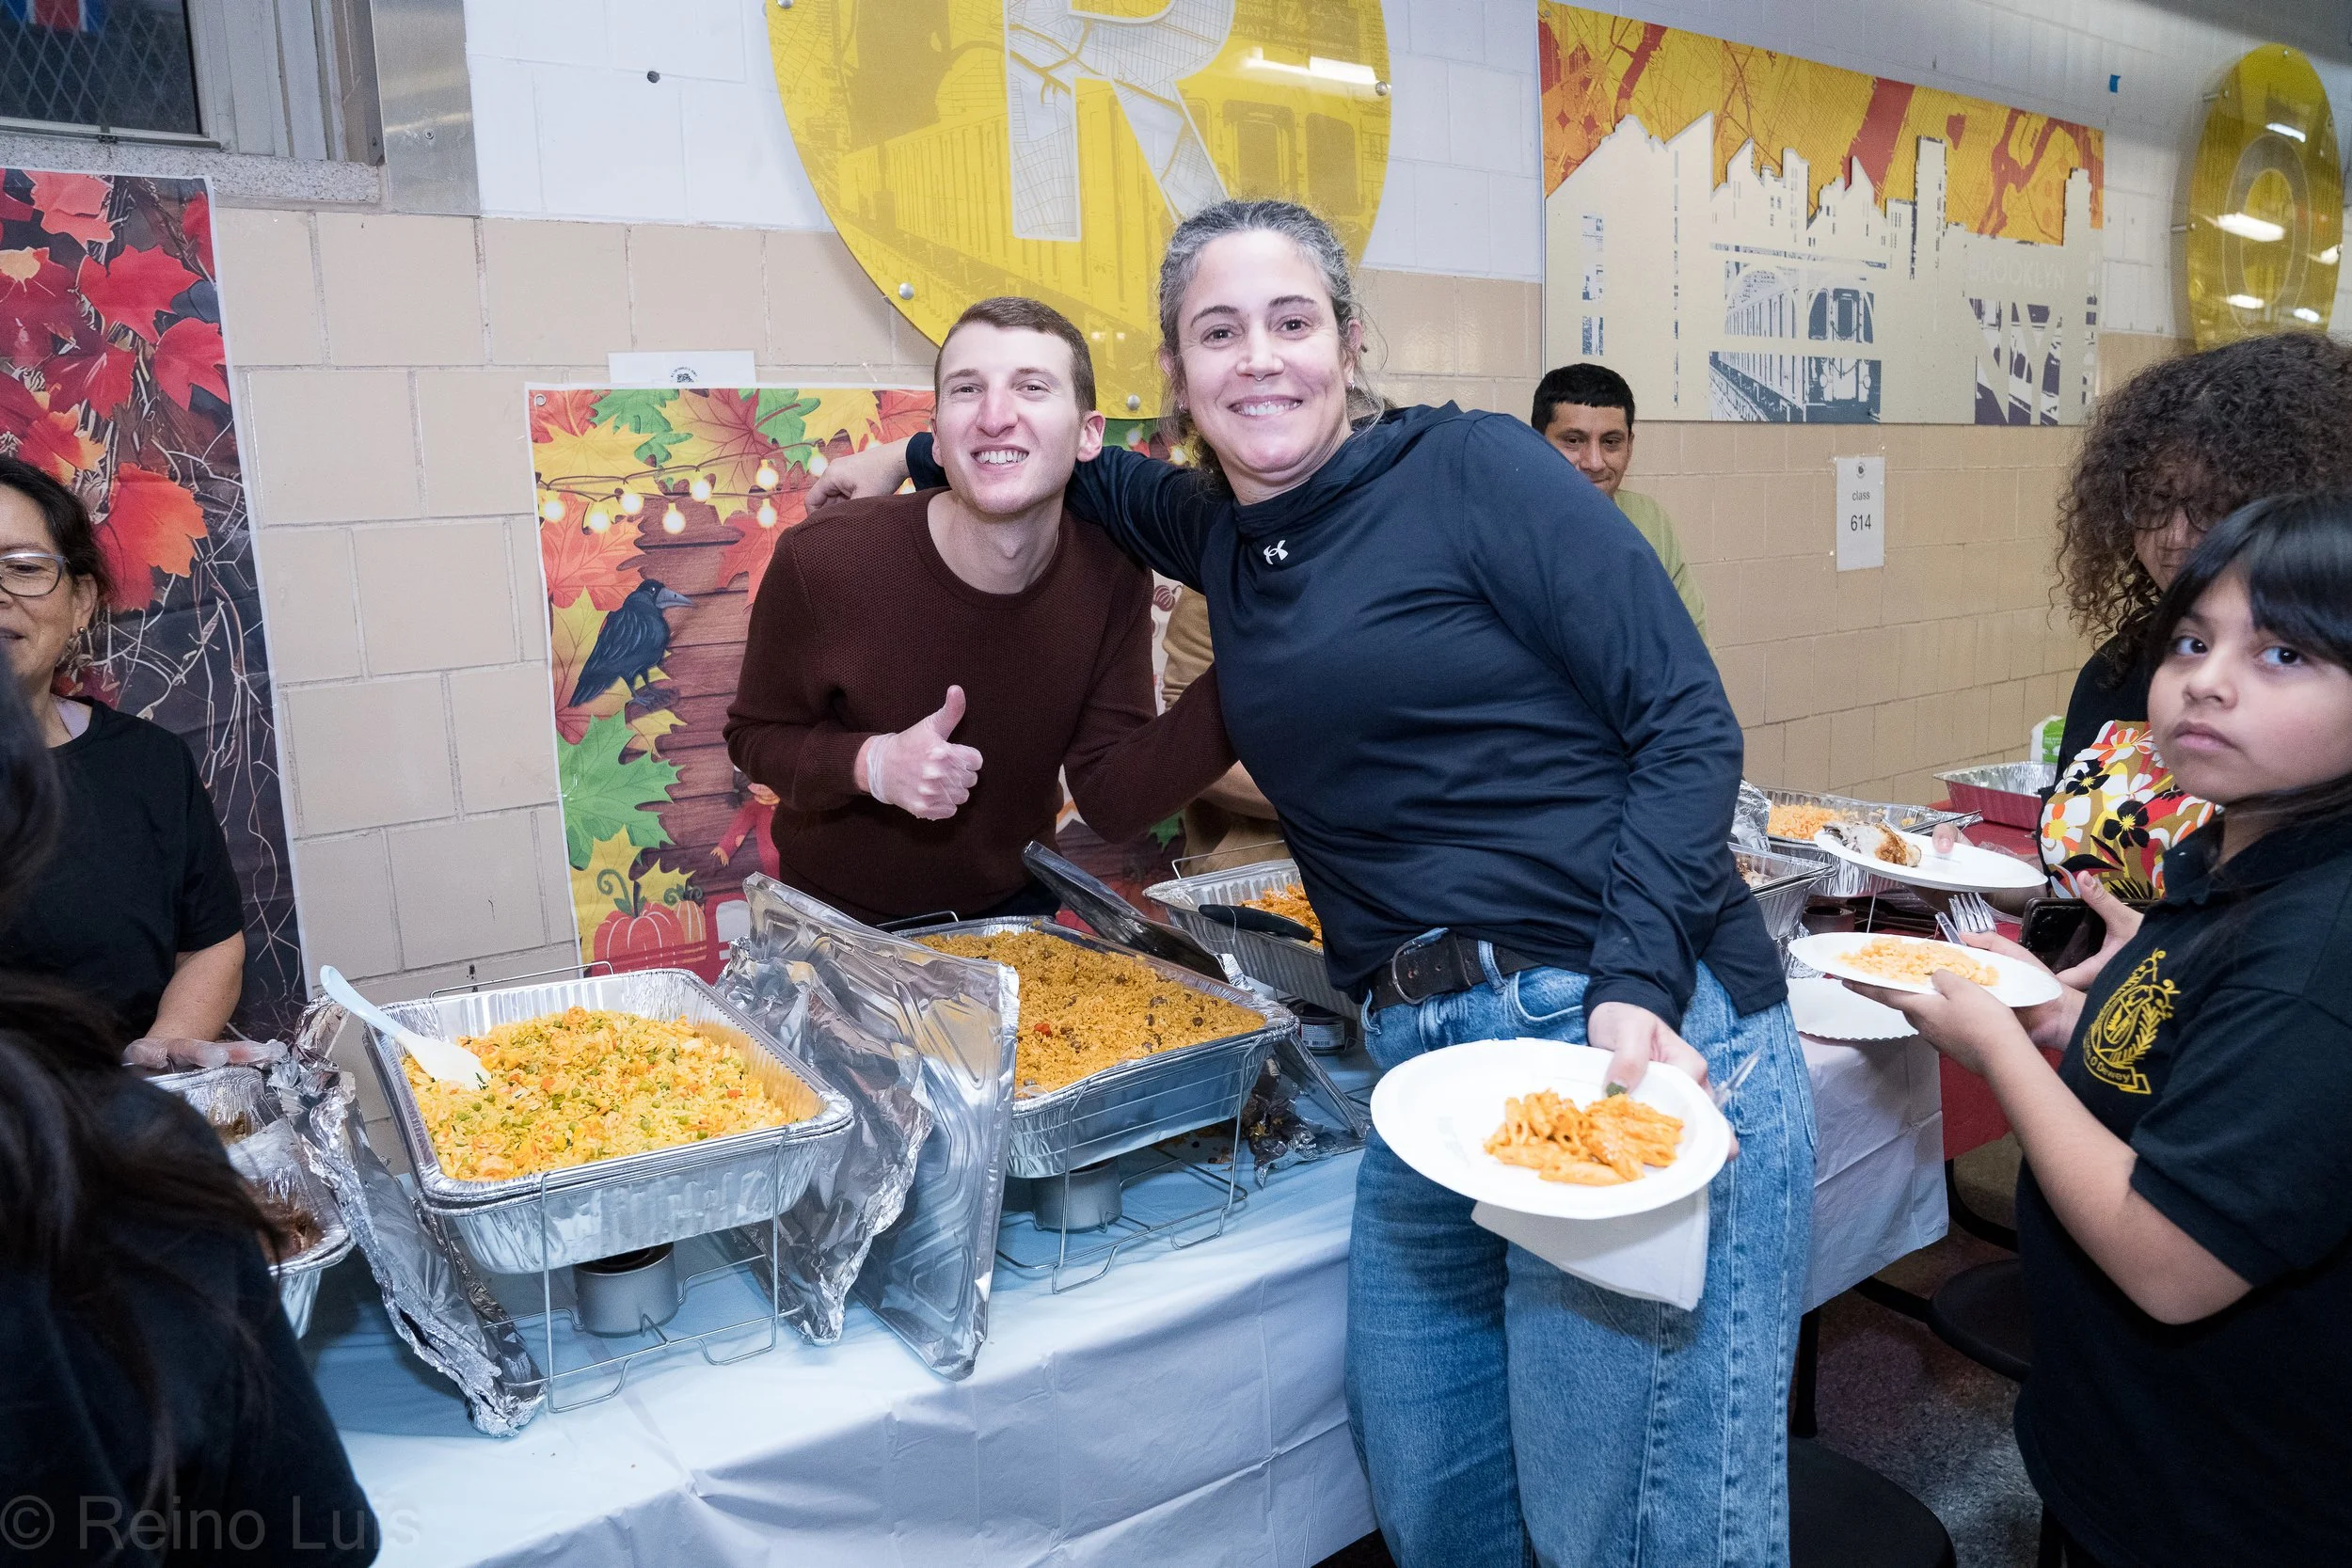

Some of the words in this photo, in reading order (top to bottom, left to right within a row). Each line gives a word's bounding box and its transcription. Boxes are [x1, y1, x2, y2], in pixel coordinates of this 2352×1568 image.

[1851, 491, 1870, 501] class
[1851, 514, 1871, 531] 614
[2096, 1061, 2131, 1084] Dewey
